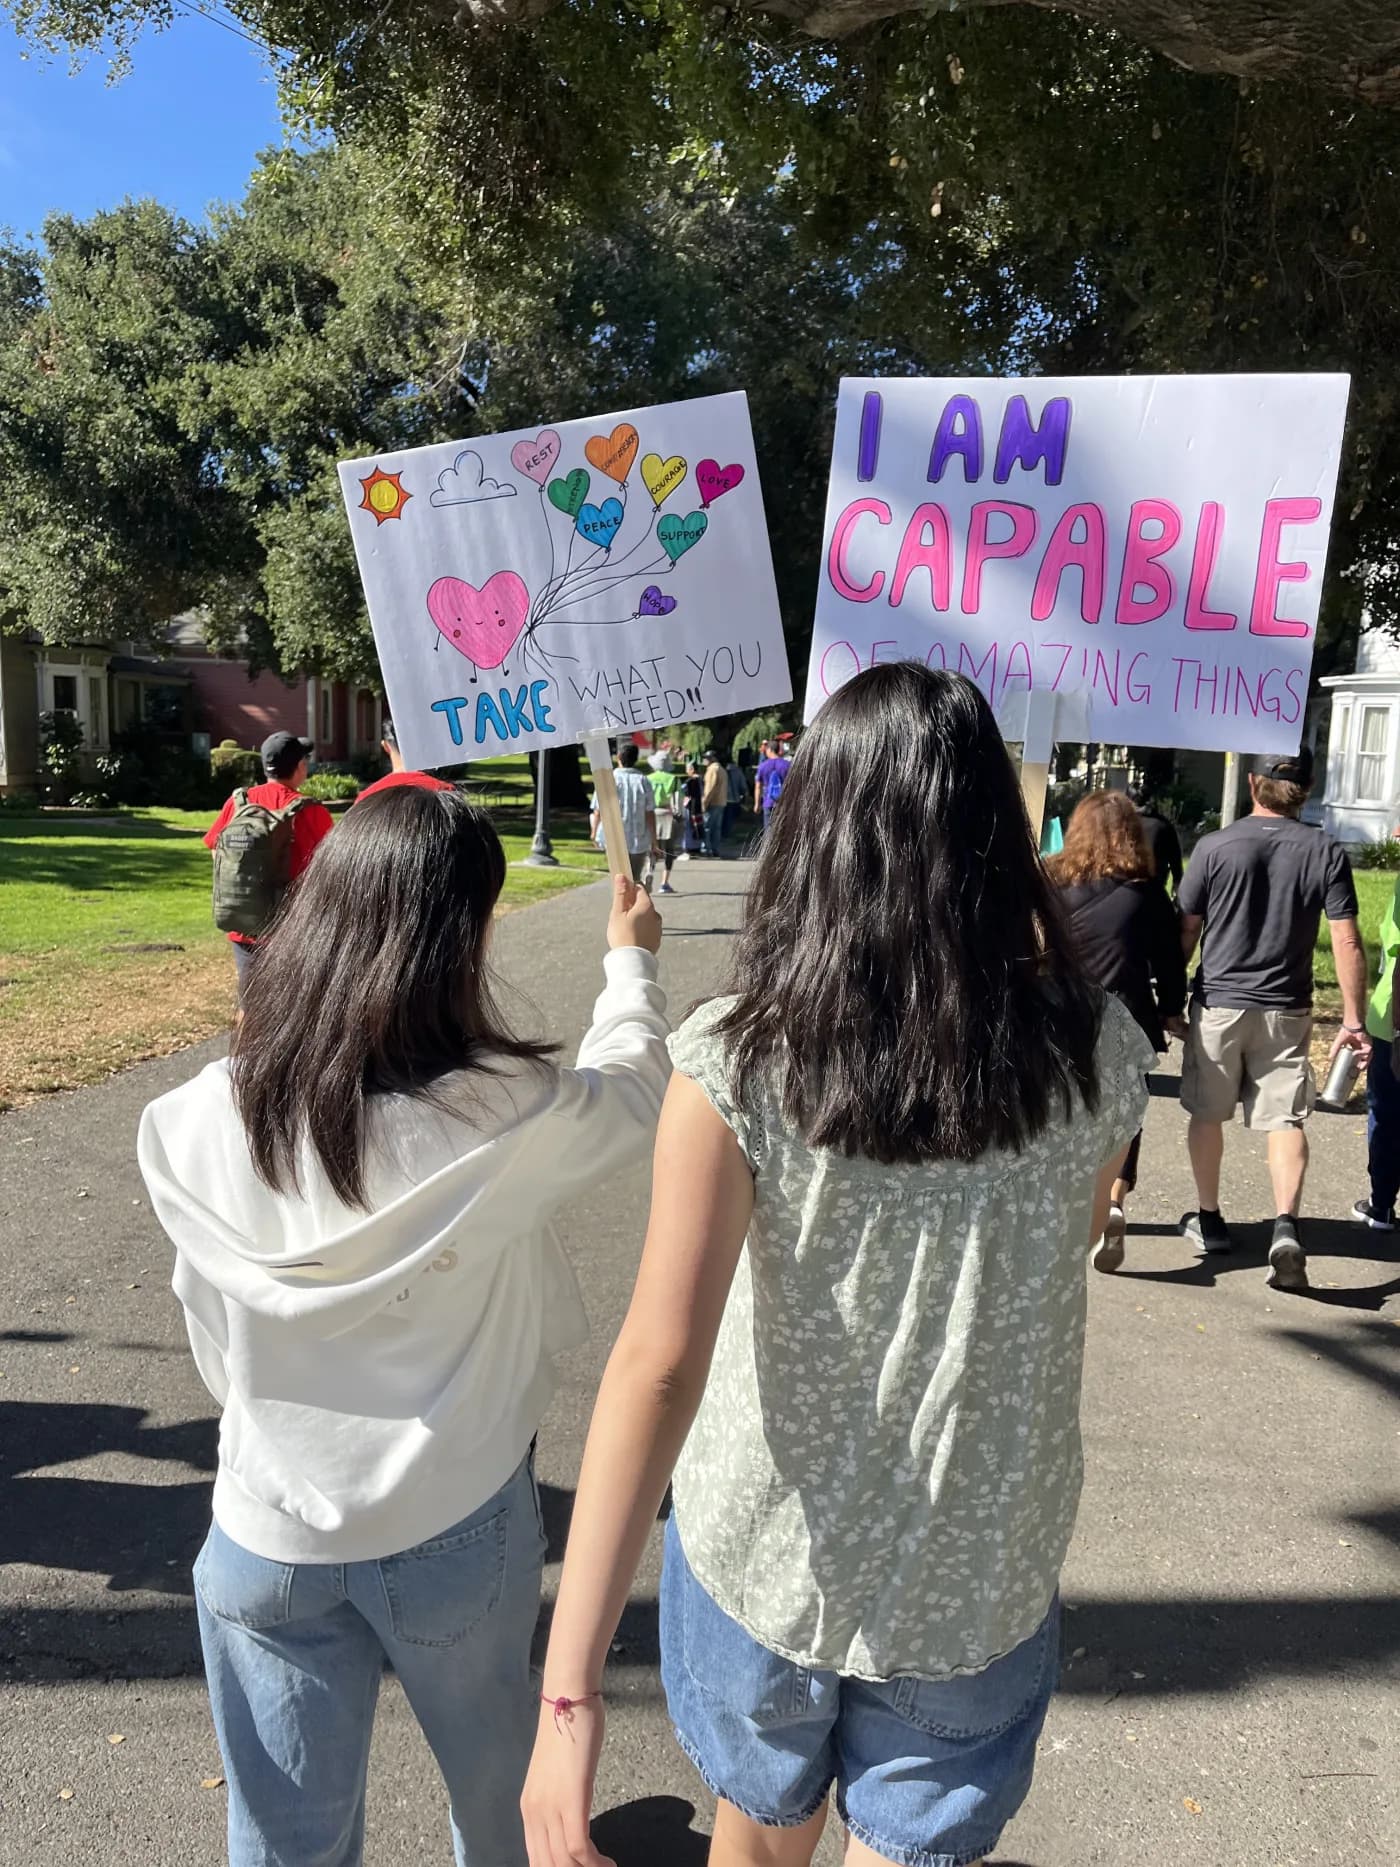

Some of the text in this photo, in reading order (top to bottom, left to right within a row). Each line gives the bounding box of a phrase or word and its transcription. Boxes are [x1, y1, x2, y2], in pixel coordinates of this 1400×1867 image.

[525, 443, 554, 472] REST
[857, 391, 1073, 486] I AM
[651, 460, 687, 495] COURAGE
[701, 474, 730, 489] LOVE
[583, 517, 621, 534] PEACE
[827, 496, 1322, 638] CAPABLE
[643, 592, 667, 616] HOPE
[431, 641, 761, 745] TAKE WHAT YOU
[603, 686, 705, 728] NEED!!
[1172, 657, 1303, 724] THINGS
